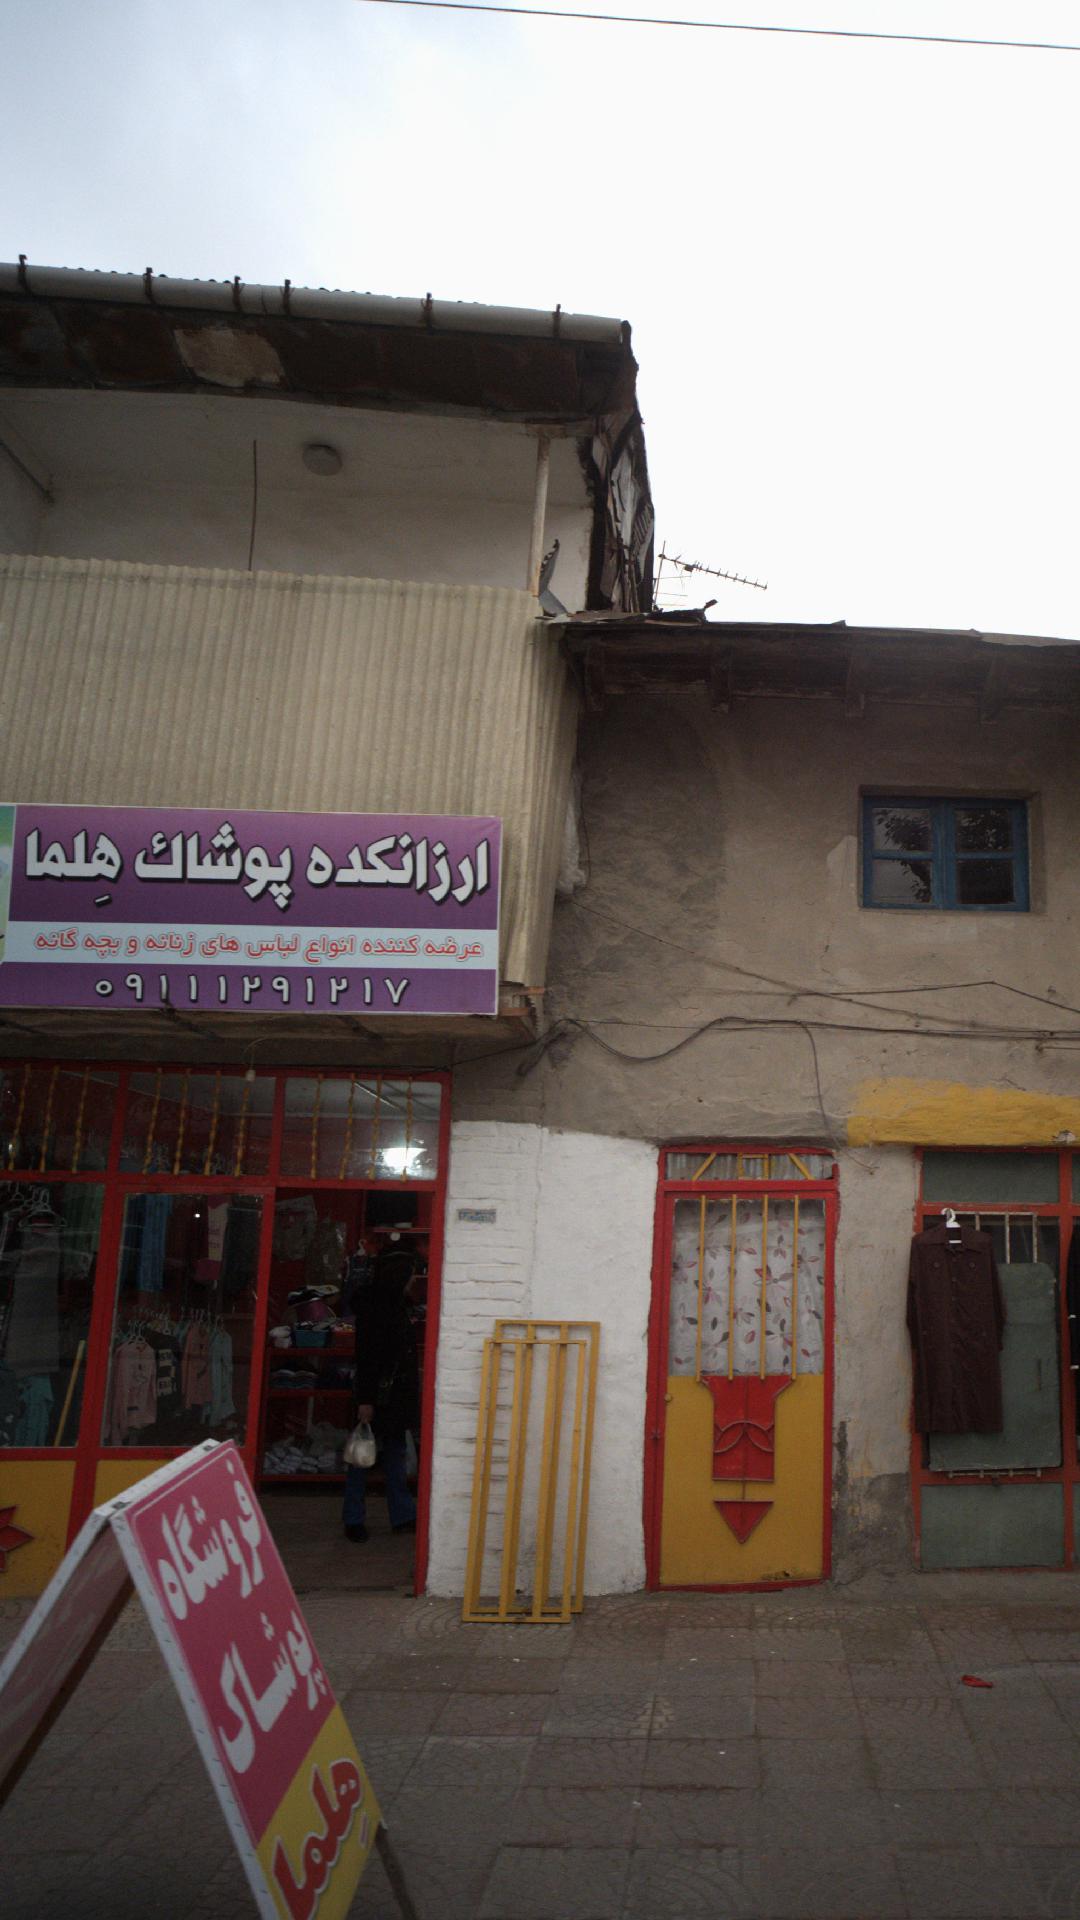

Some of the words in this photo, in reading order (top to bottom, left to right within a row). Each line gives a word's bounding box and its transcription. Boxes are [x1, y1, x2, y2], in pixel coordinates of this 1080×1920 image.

[305, 833, 489, 905] ارزانکده
[35, 928, 78, 950] گانه
[83, 935, 121, 957] بچه
[126, 935, 140, 955] و
[146, 932, 195, 957] زنانه
[201, 934, 240, 957] های
[247, 934, 300, 958] لباس
[304, 934, 355, 965] انواع
[362, 935, 419, 955] کننده
[424, 936, 484, 961] عرضه
[156, 1459, 263, 1620] فروشگاه
